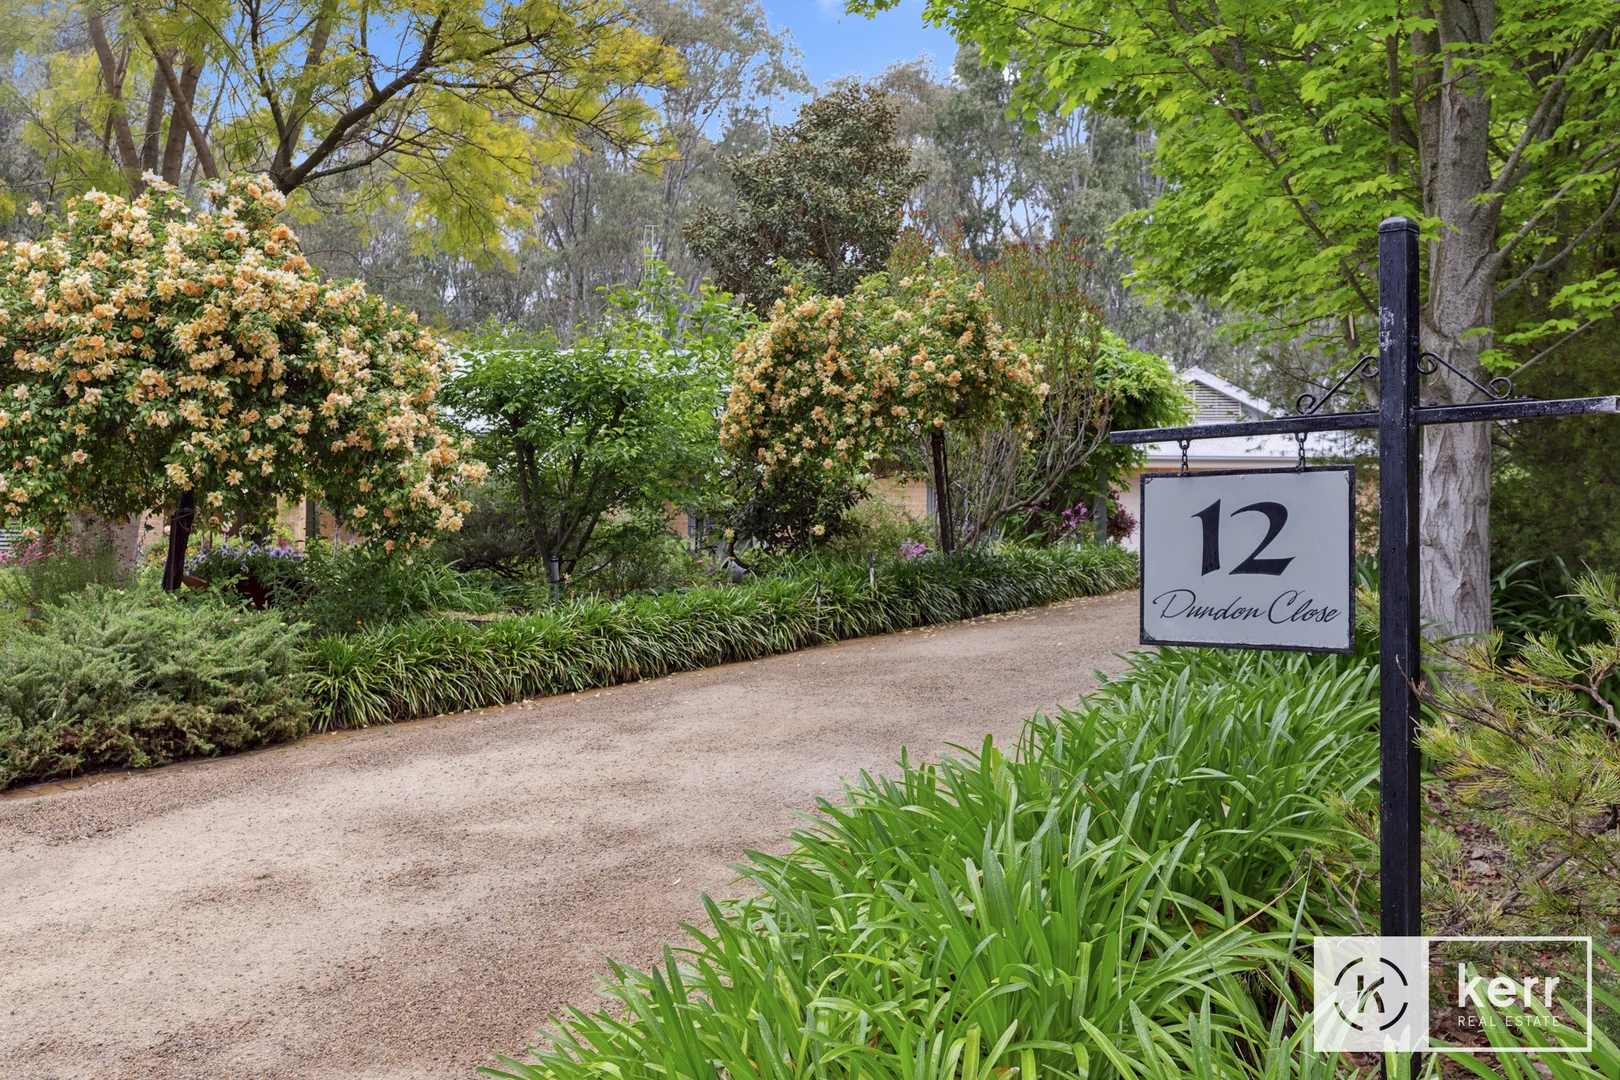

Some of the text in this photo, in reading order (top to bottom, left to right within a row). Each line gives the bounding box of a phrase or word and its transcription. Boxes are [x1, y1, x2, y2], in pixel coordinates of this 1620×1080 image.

[1191, 498, 1297, 576] 12
[1152, 588, 1341, 625] Dundon Close
